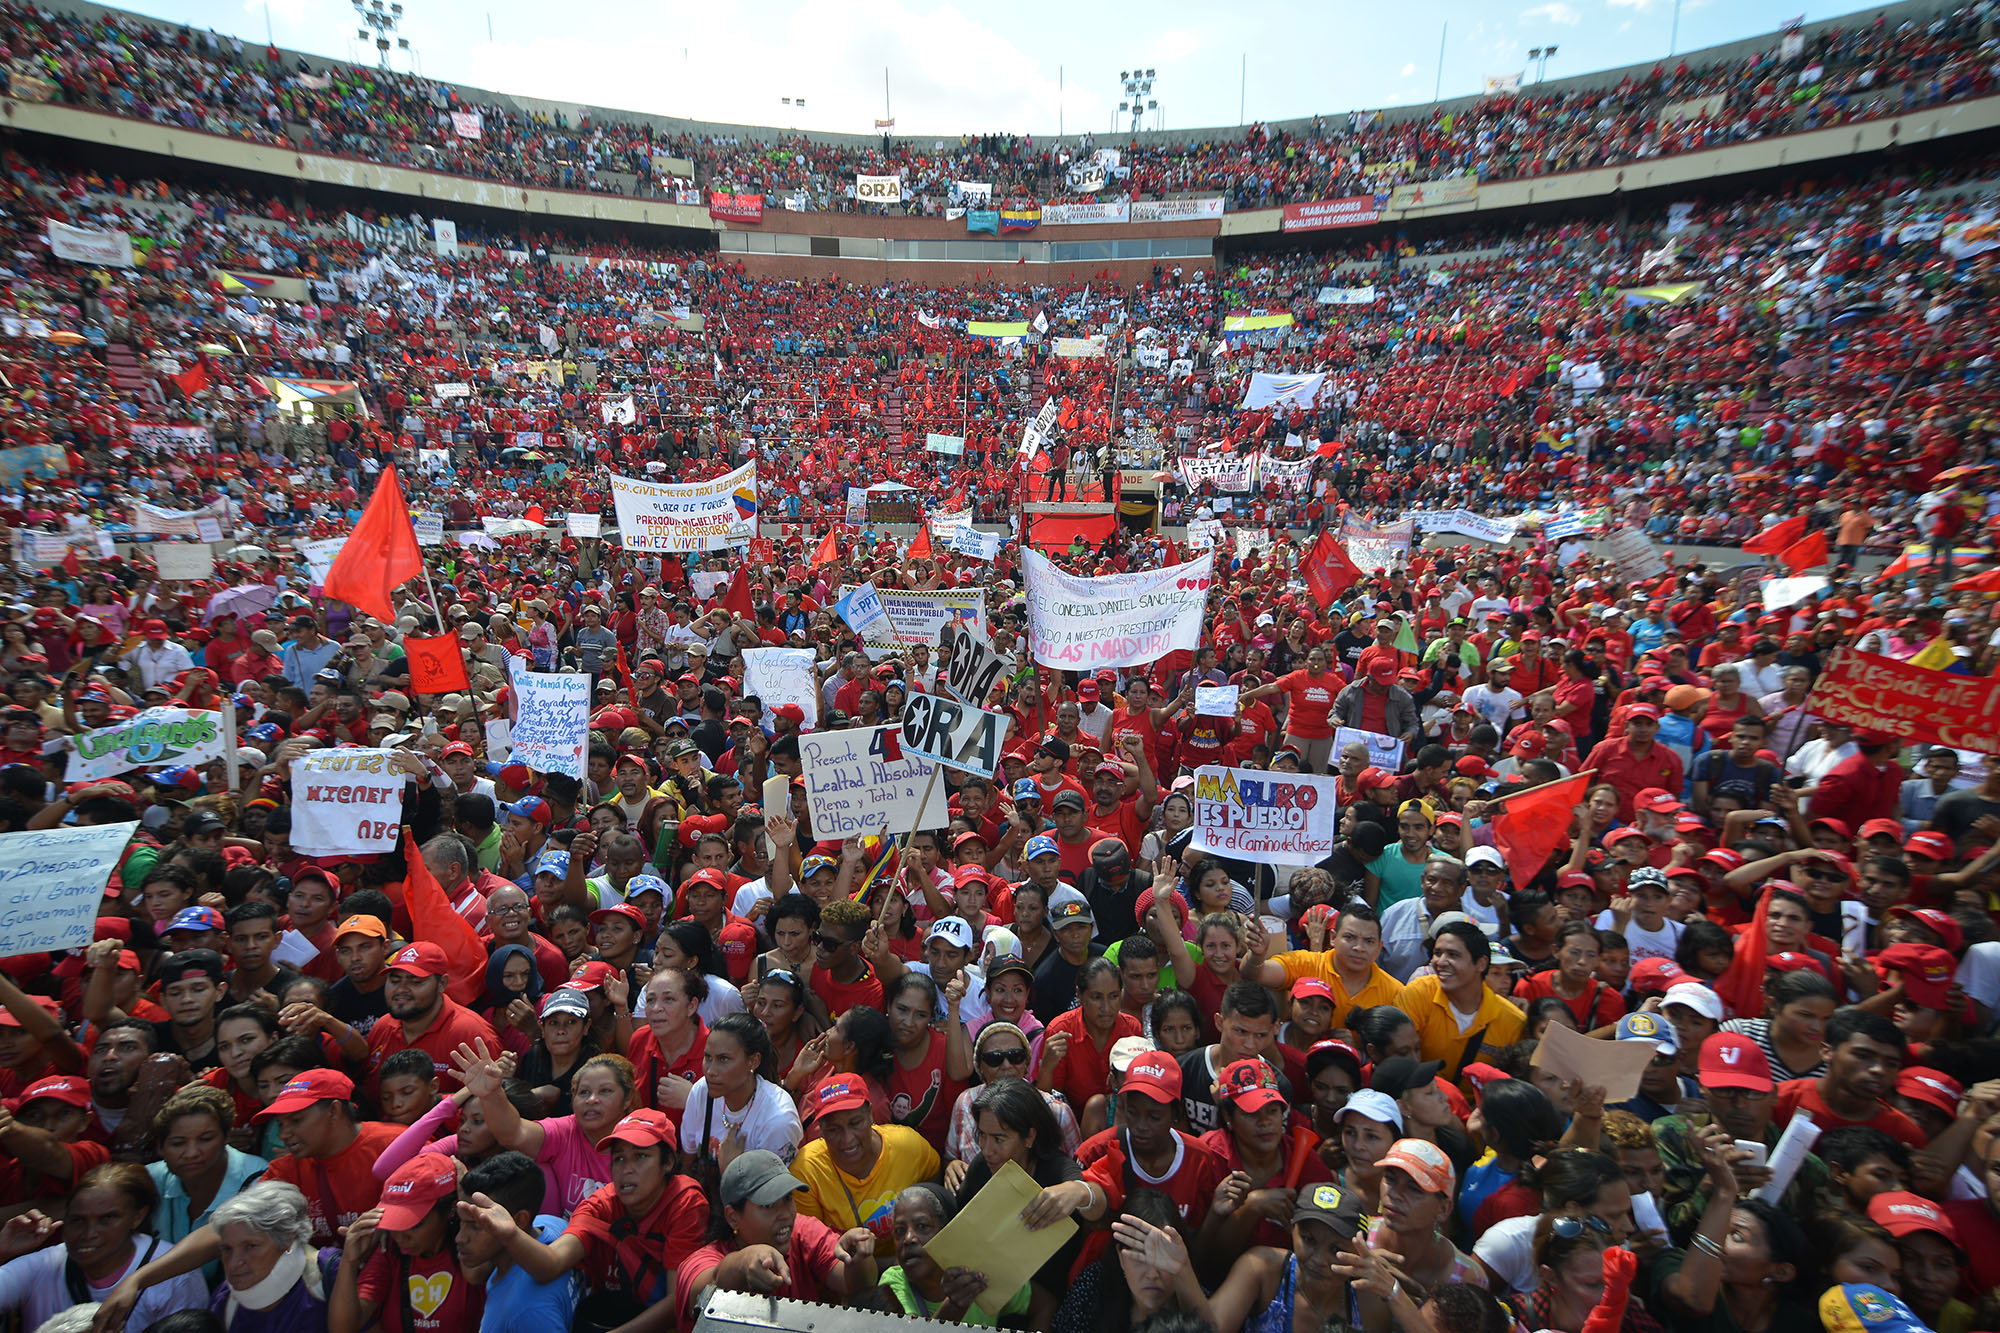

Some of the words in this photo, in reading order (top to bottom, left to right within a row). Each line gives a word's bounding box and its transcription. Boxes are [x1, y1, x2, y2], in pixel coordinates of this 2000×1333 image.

[859, 182, 899, 197] ORA
[1163, 208, 1198, 216] VIVIENDO
[1300, 201, 1361, 217] TRABAJADORES
[1284, 216, 1323, 228] SOCIALISTAS
[1323, 216, 1332, 225] DE
[1332, 211, 1378, 224] CORPOCENTRO
[659, 488, 693, 498] METRO
[653, 502, 679, 513] PLAZA
[683, 503, 696, 513] DE
[701, 498, 728, 511] TOROS
[675, 523, 730, 537] CARABOBO
[626, 535, 668, 549] CHAVEZ
[858, 592, 879, 614] PPT
[887, 607, 906, 616] TAXIS
[907, 608, 919, 617] DEL
[920, 609, 945, 618] PUEBLO
[902, 600, 934, 609] NACIONAL
[1052, 601, 1098, 617] CONCEJAL
[1100, 599, 1137, 615] DANIEL
[1140, 591, 1187, 609] SANCHEZ
[1074, 625, 1115, 642] NUESTRO
[1119, 615, 1178, 637] PRESIDENTE
[1091, 632, 1171, 661] MADURO
[562, 677, 586, 692] Rosa
[903, 695, 996, 773] ORA
[804, 741, 858, 769] Presente
[809, 766, 866, 794] Lealtad
[870, 756, 933, 785] Absoluta
[1196, 768, 1318, 810] MADURO
[814, 796, 850, 813] Plena
[858, 800, 864, 809] y
[866, 787, 898, 803] Total
[906, 788, 915, 798] a
[1200, 803, 1224, 827] ES
[1227, 805, 1305, 830] PUEBLO
[1205, 827, 1222, 846] Por
[1225, 827, 1237, 849] el
[1238, 831, 1281, 852] Camino
[1281, 834, 1291, 852] de
[10, 884, 44, 904] del
[48, 881, 98, 901] Barrio
[933, 921, 962, 936] ORA
